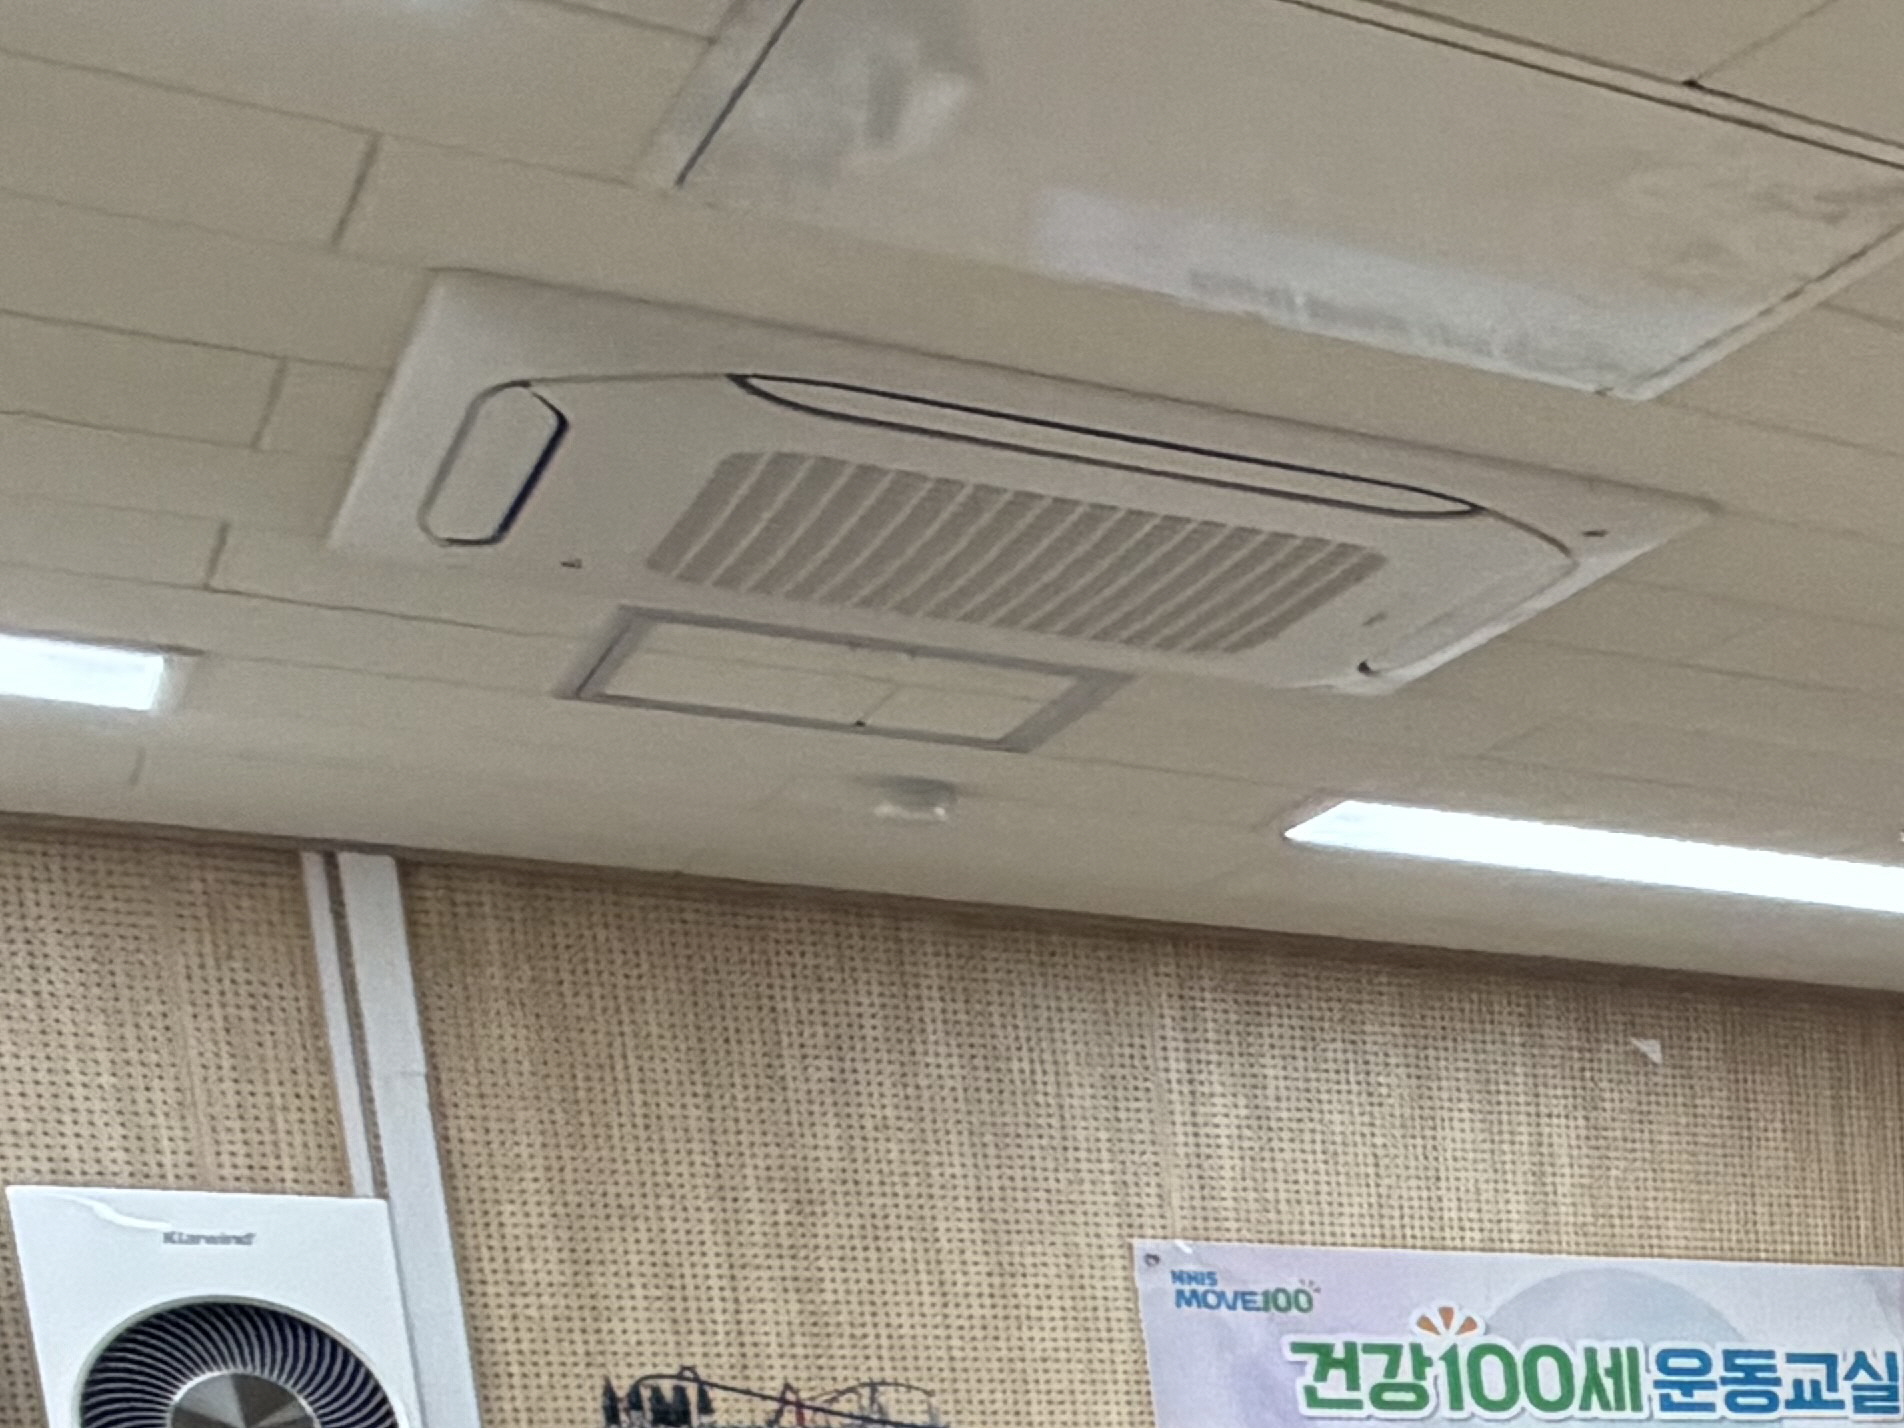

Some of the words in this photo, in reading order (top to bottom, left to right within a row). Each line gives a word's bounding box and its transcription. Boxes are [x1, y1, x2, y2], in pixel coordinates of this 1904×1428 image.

[1174, 1287, 1315, 1314] MOVE100
[1290, 1340, 1644, 1413] 건강100세
[1652, 1346, 1902, 1415] 운동교실
